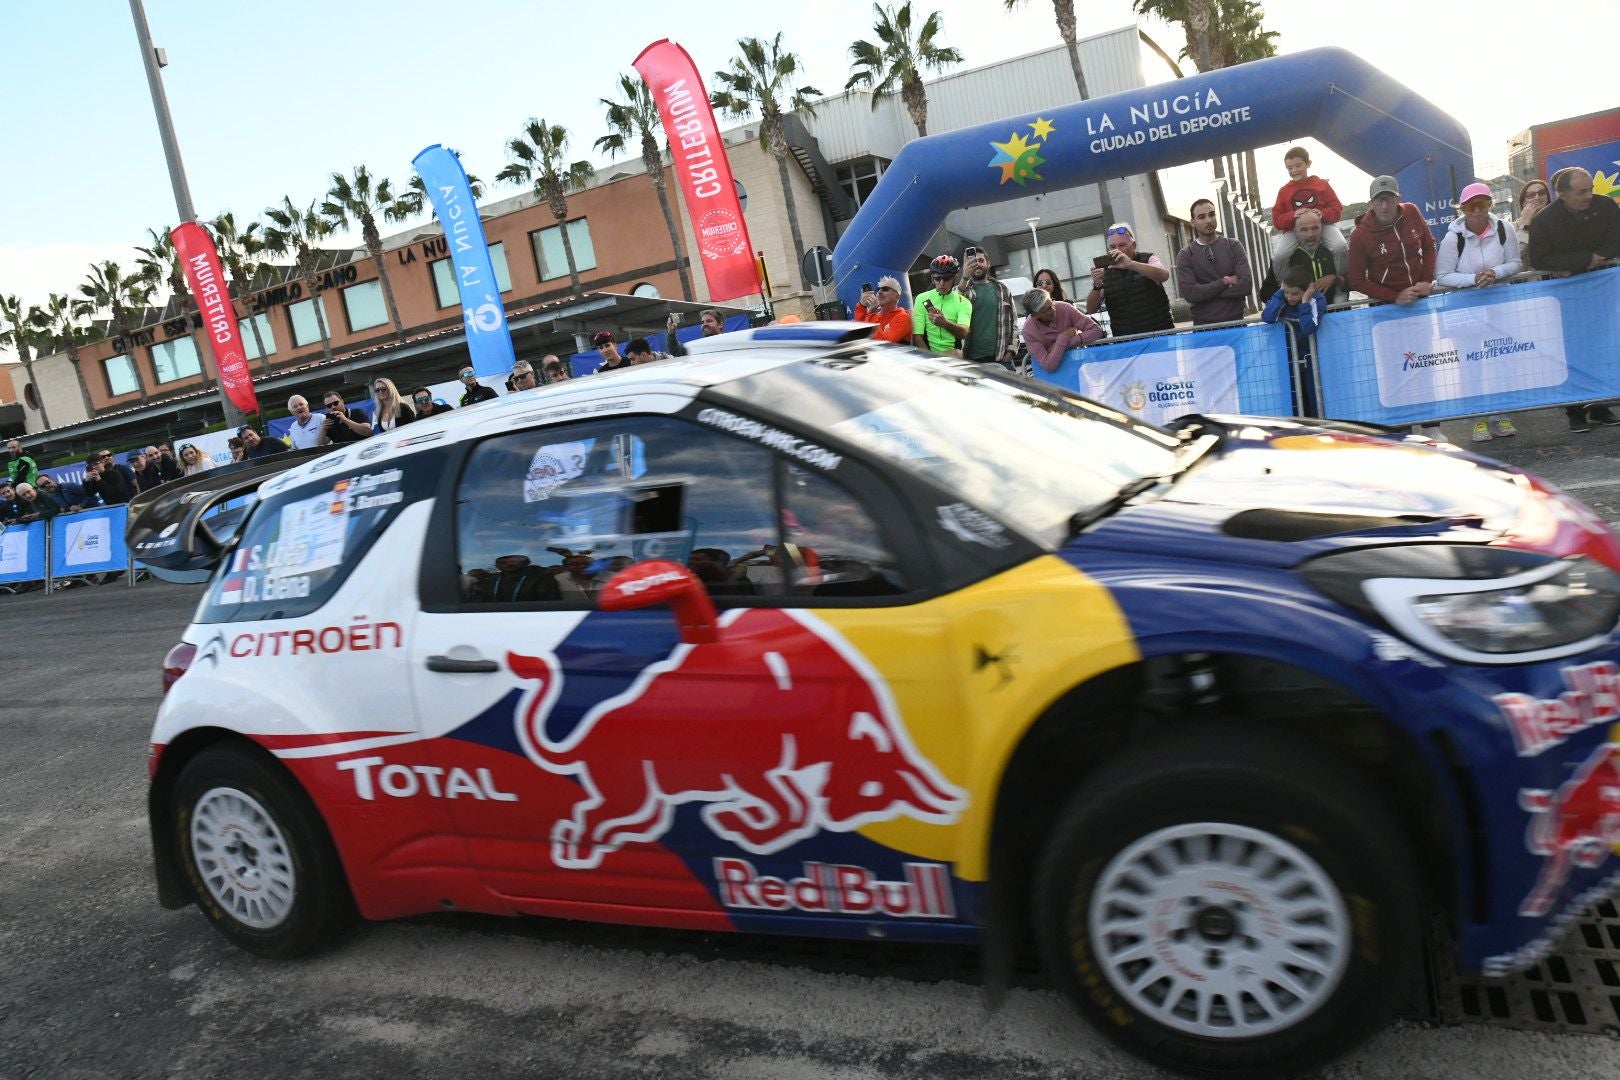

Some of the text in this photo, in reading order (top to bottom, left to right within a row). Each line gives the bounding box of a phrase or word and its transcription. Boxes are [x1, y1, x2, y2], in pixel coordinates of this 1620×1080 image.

[1087, 112, 1115, 136] LA
[1090, 106, 1252, 154] CIUDAD DEL DEPORTE
[398, 249, 416, 266] LA
[1484, 337, 1513, 349] ACTITUD
[1409, 356, 1460, 370] VALENCIANA
[1417, 350, 1459, 362] COMUNITAT
[1155, 381, 1194, 392] Costa
[1148, 390, 1195, 402] Blanca
[712, 856, 957, 919] Red Bull
